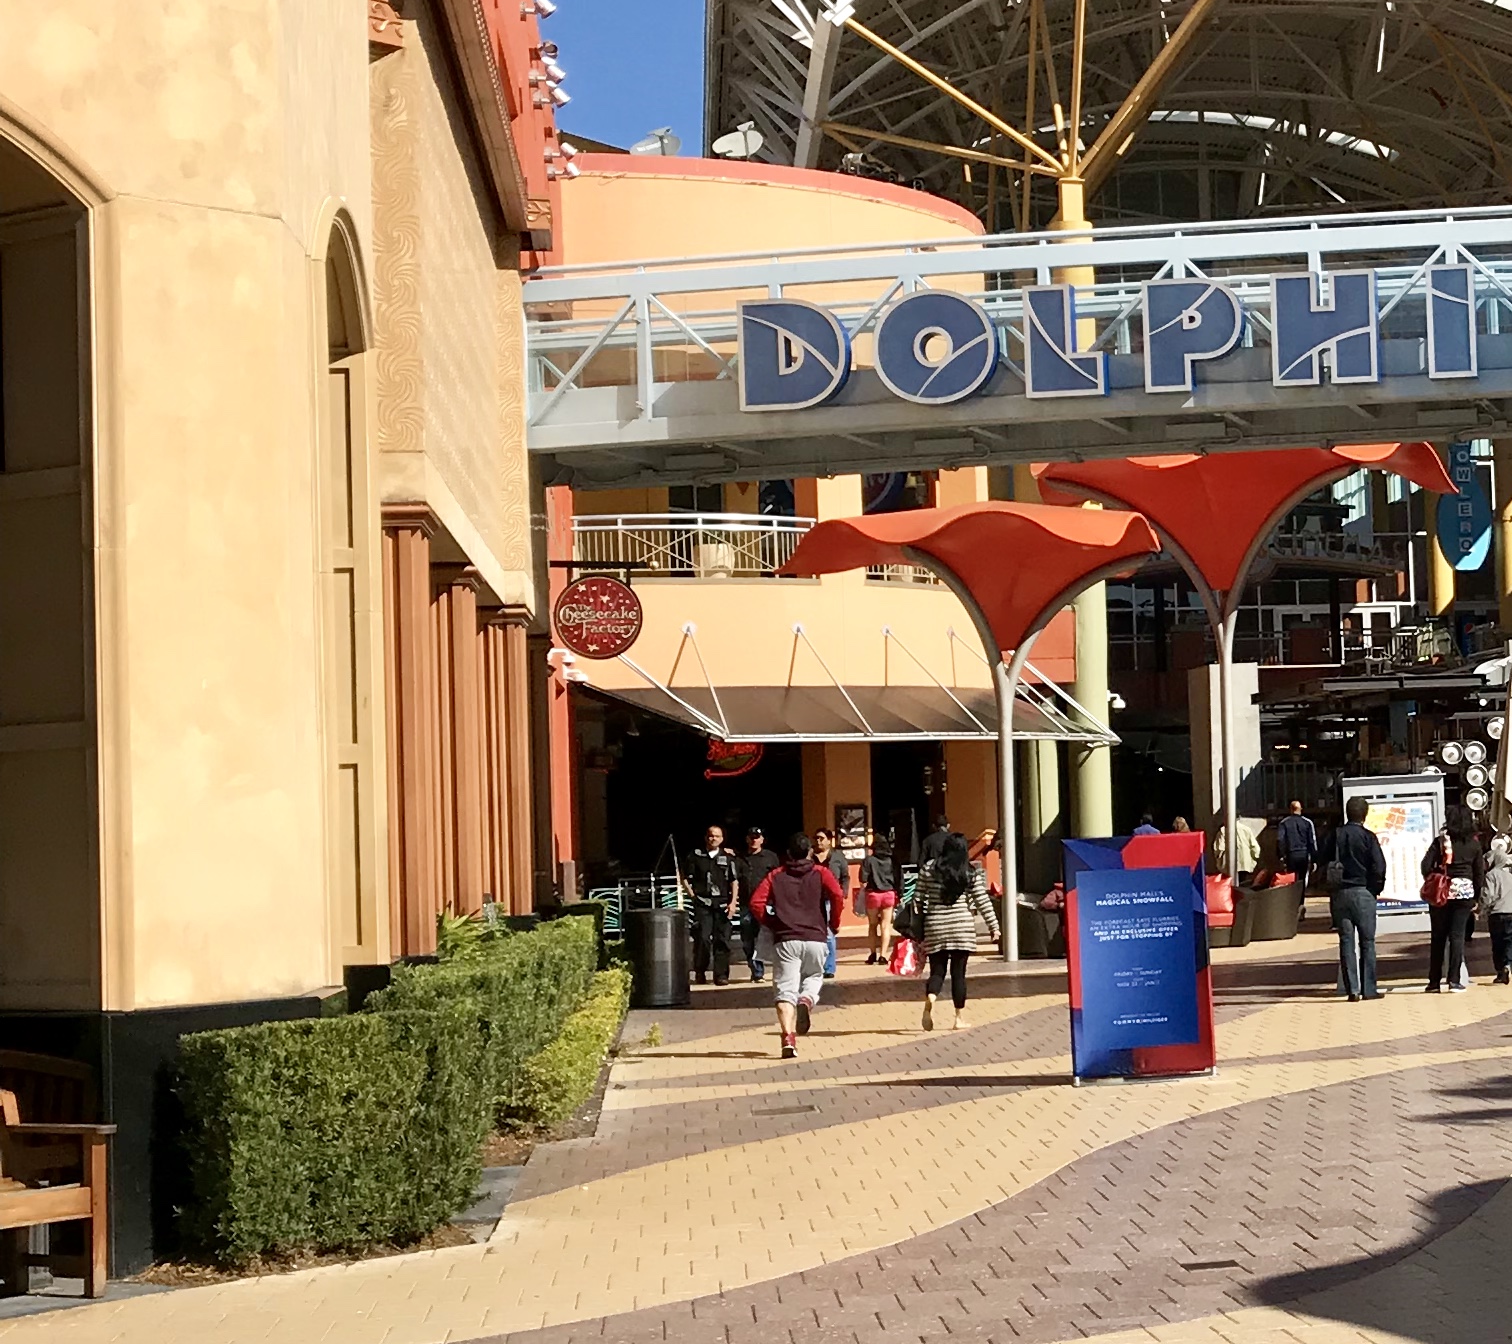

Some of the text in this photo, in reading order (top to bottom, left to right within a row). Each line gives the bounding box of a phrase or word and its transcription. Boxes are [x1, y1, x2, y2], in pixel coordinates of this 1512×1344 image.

[1455, 439, 1474, 552] OWLERO
[560, 603, 637, 626] Cheesecake
[577, 619, 637, 640] Factory
[1096, 896, 1174, 906] MAGICAL SNOWFALL
[1131, 932, 1163, 940] STOPPING
